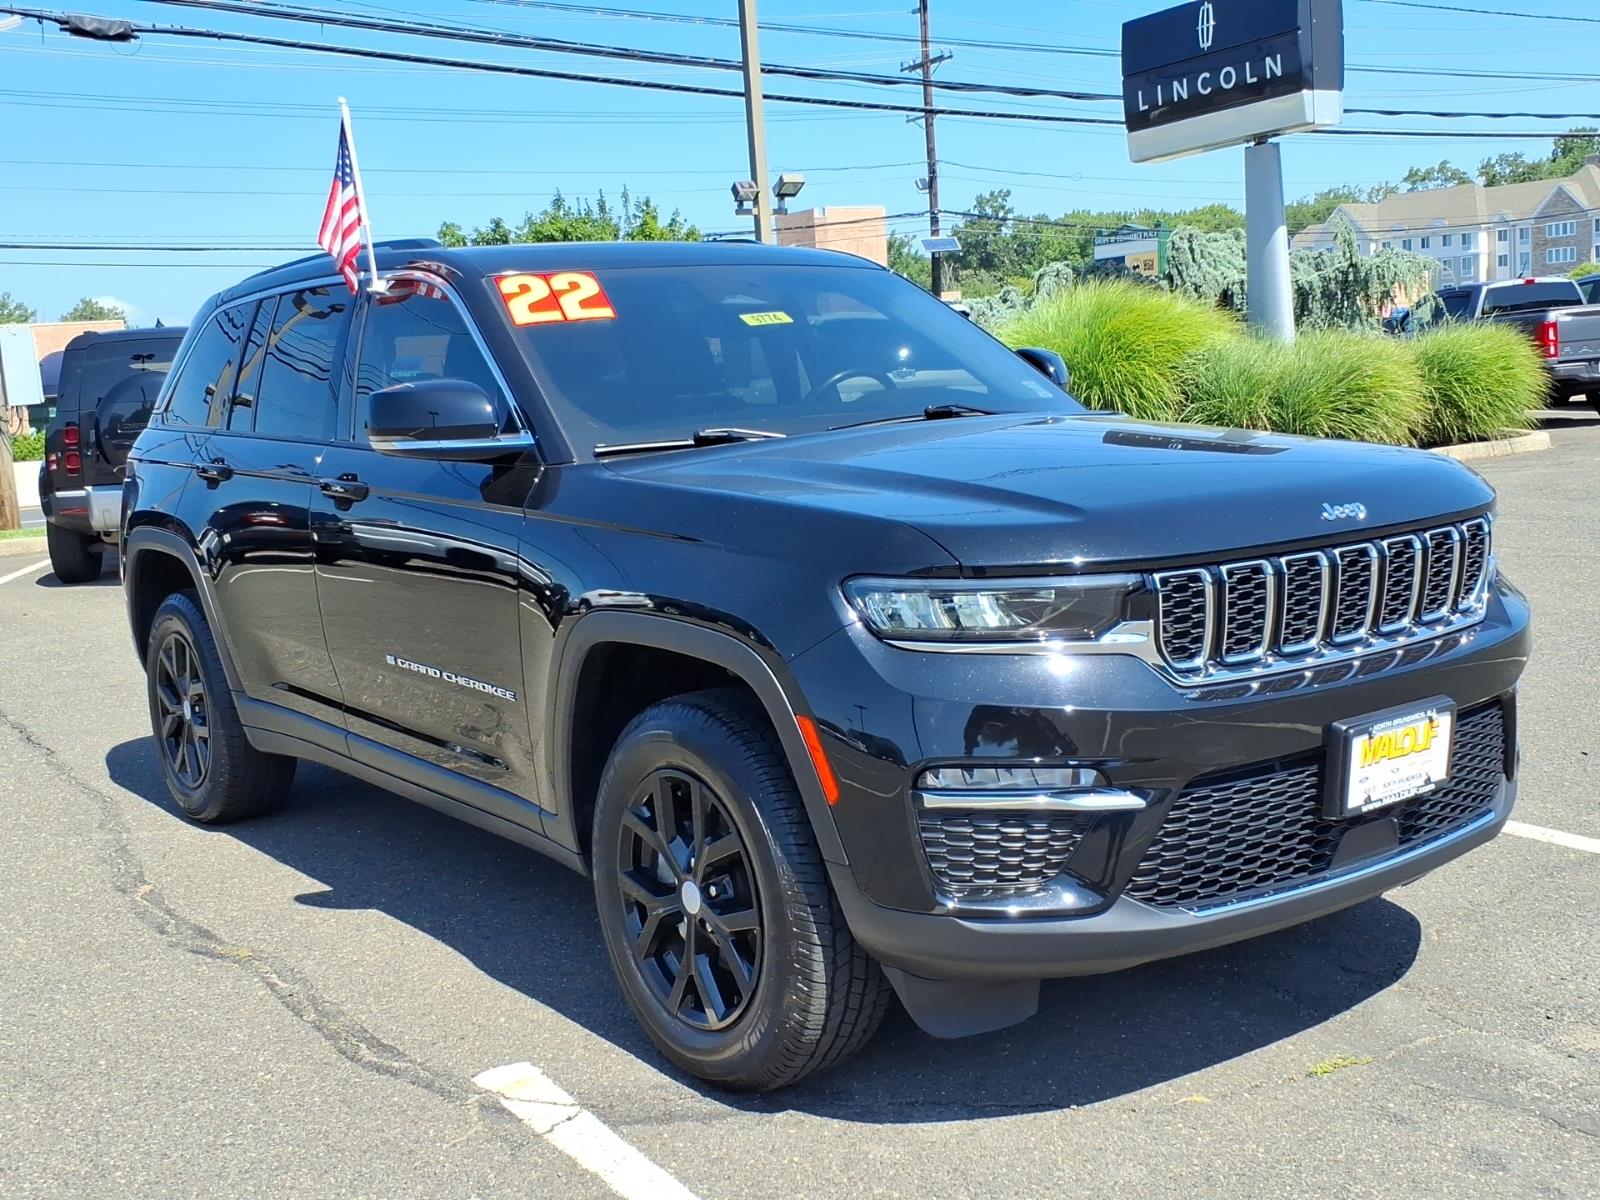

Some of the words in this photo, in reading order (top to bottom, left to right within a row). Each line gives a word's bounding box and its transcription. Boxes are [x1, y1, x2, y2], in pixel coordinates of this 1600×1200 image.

[1138, 54, 1282, 111] LINCOLN
[499, 272, 617, 326] 22
[1320, 502, 1367, 521] Jeep
[397, 658, 440, 678] GRAND
[442, 672, 517, 702] CHEROKEE
[1360, 720, 1439, 769] MALOUF
